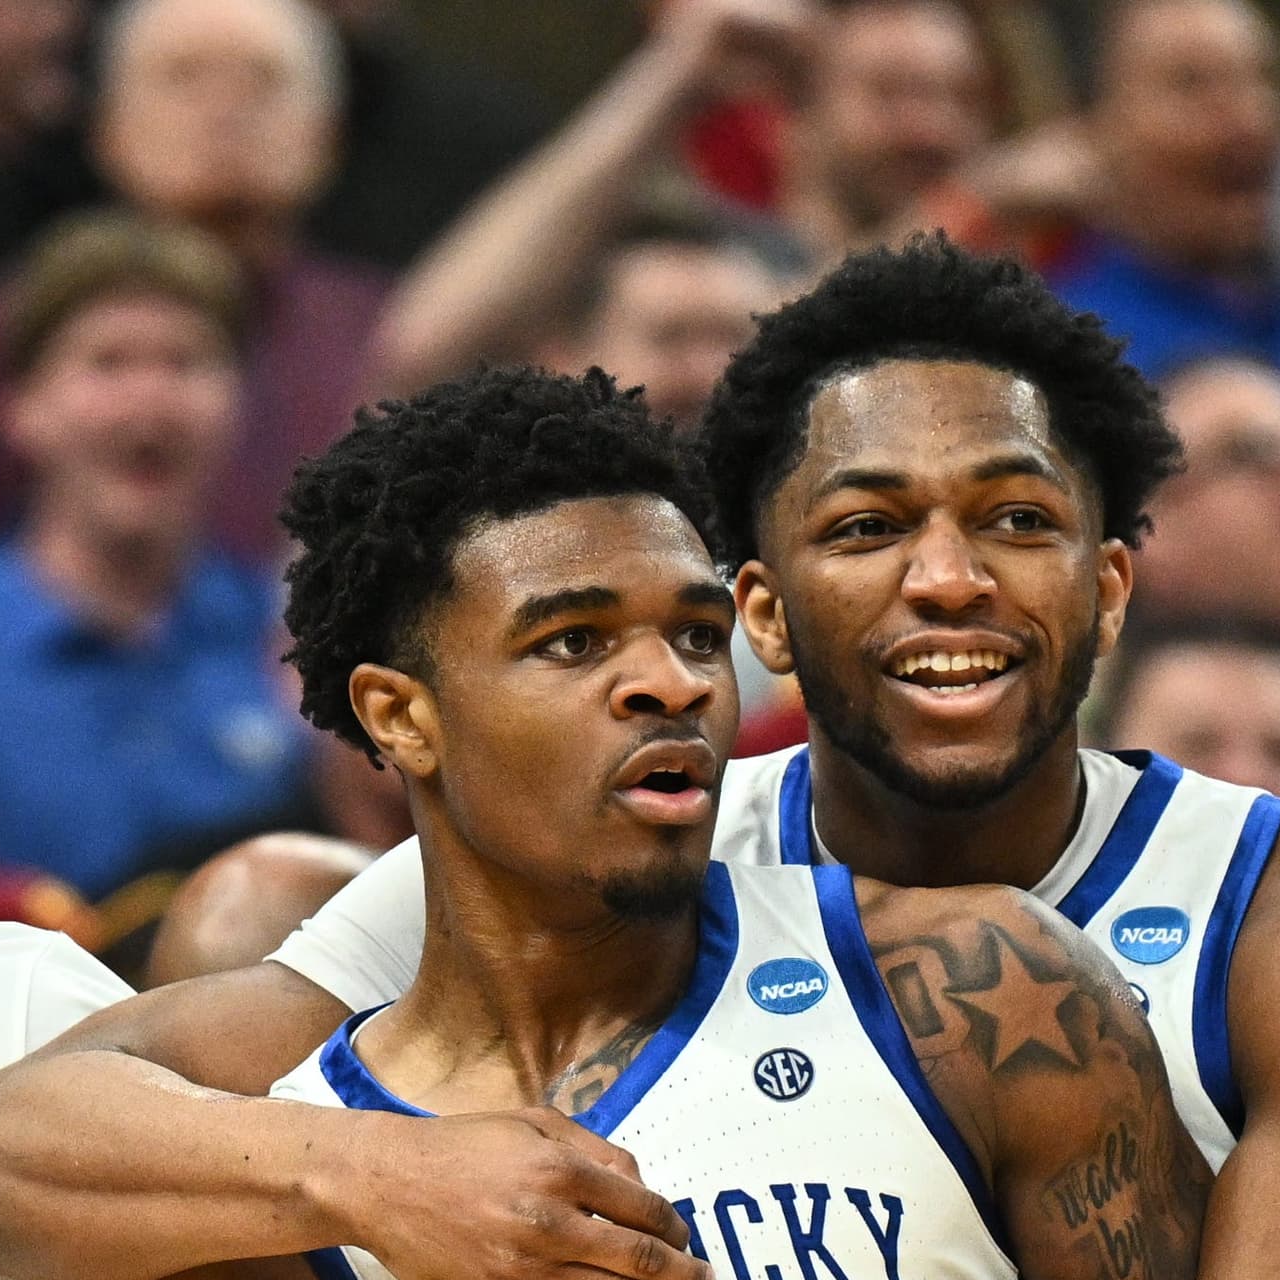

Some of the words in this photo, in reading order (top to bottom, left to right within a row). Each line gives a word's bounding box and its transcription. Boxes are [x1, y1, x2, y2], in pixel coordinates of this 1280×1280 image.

[1119, 927, 1184, 944] NCAA
[760, 978, 824, 1001] NCAA
[757, 1052, 810, 1096] SEC
